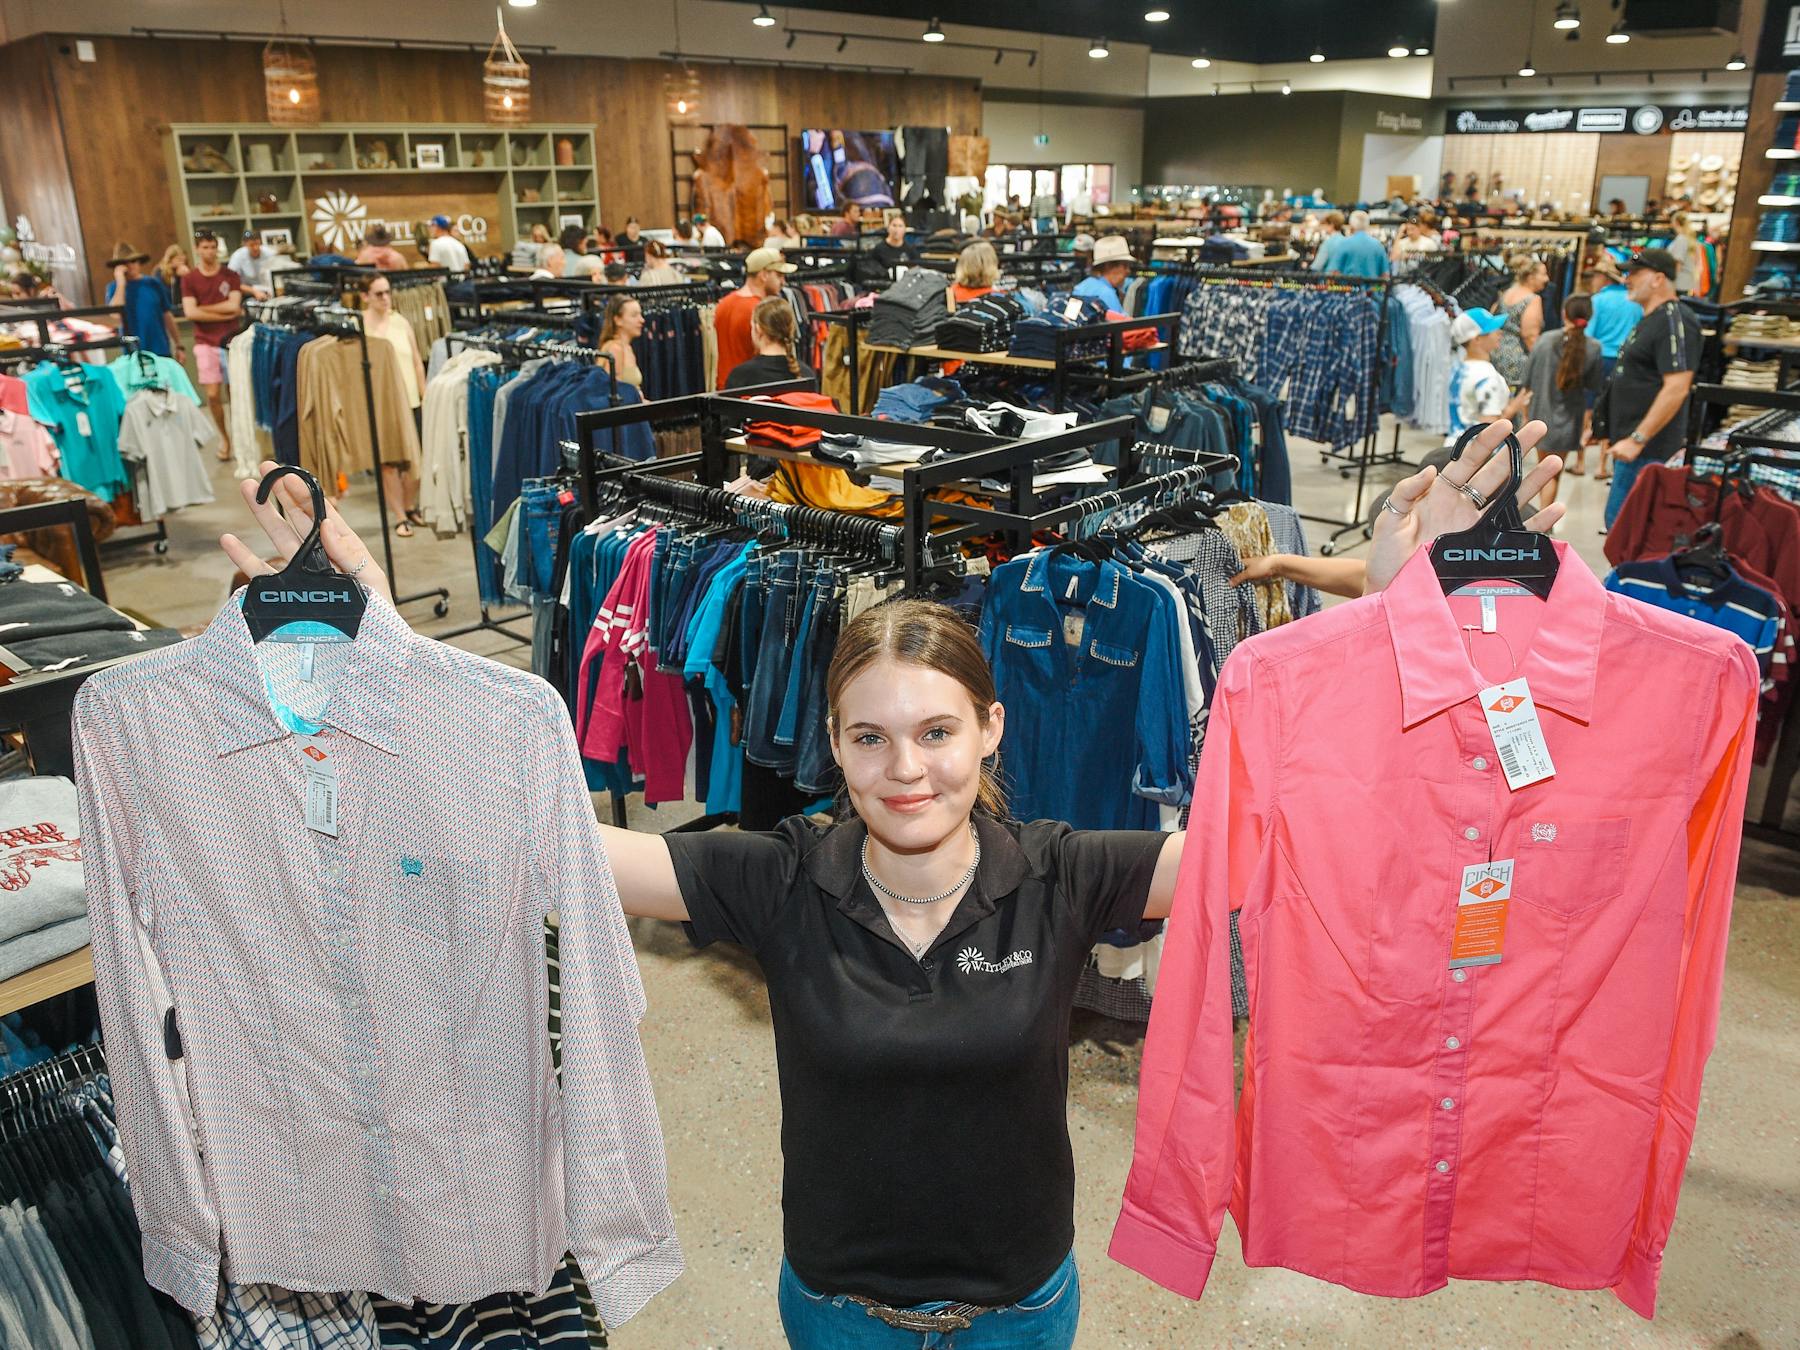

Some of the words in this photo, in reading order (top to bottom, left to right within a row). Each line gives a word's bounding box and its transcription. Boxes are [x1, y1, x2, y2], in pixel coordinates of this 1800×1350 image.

[1443, 549, 1541, 561] CINCH
[259, 591, 350, 603] CINCH
[1465, 866, 1511, 887] CINCH
